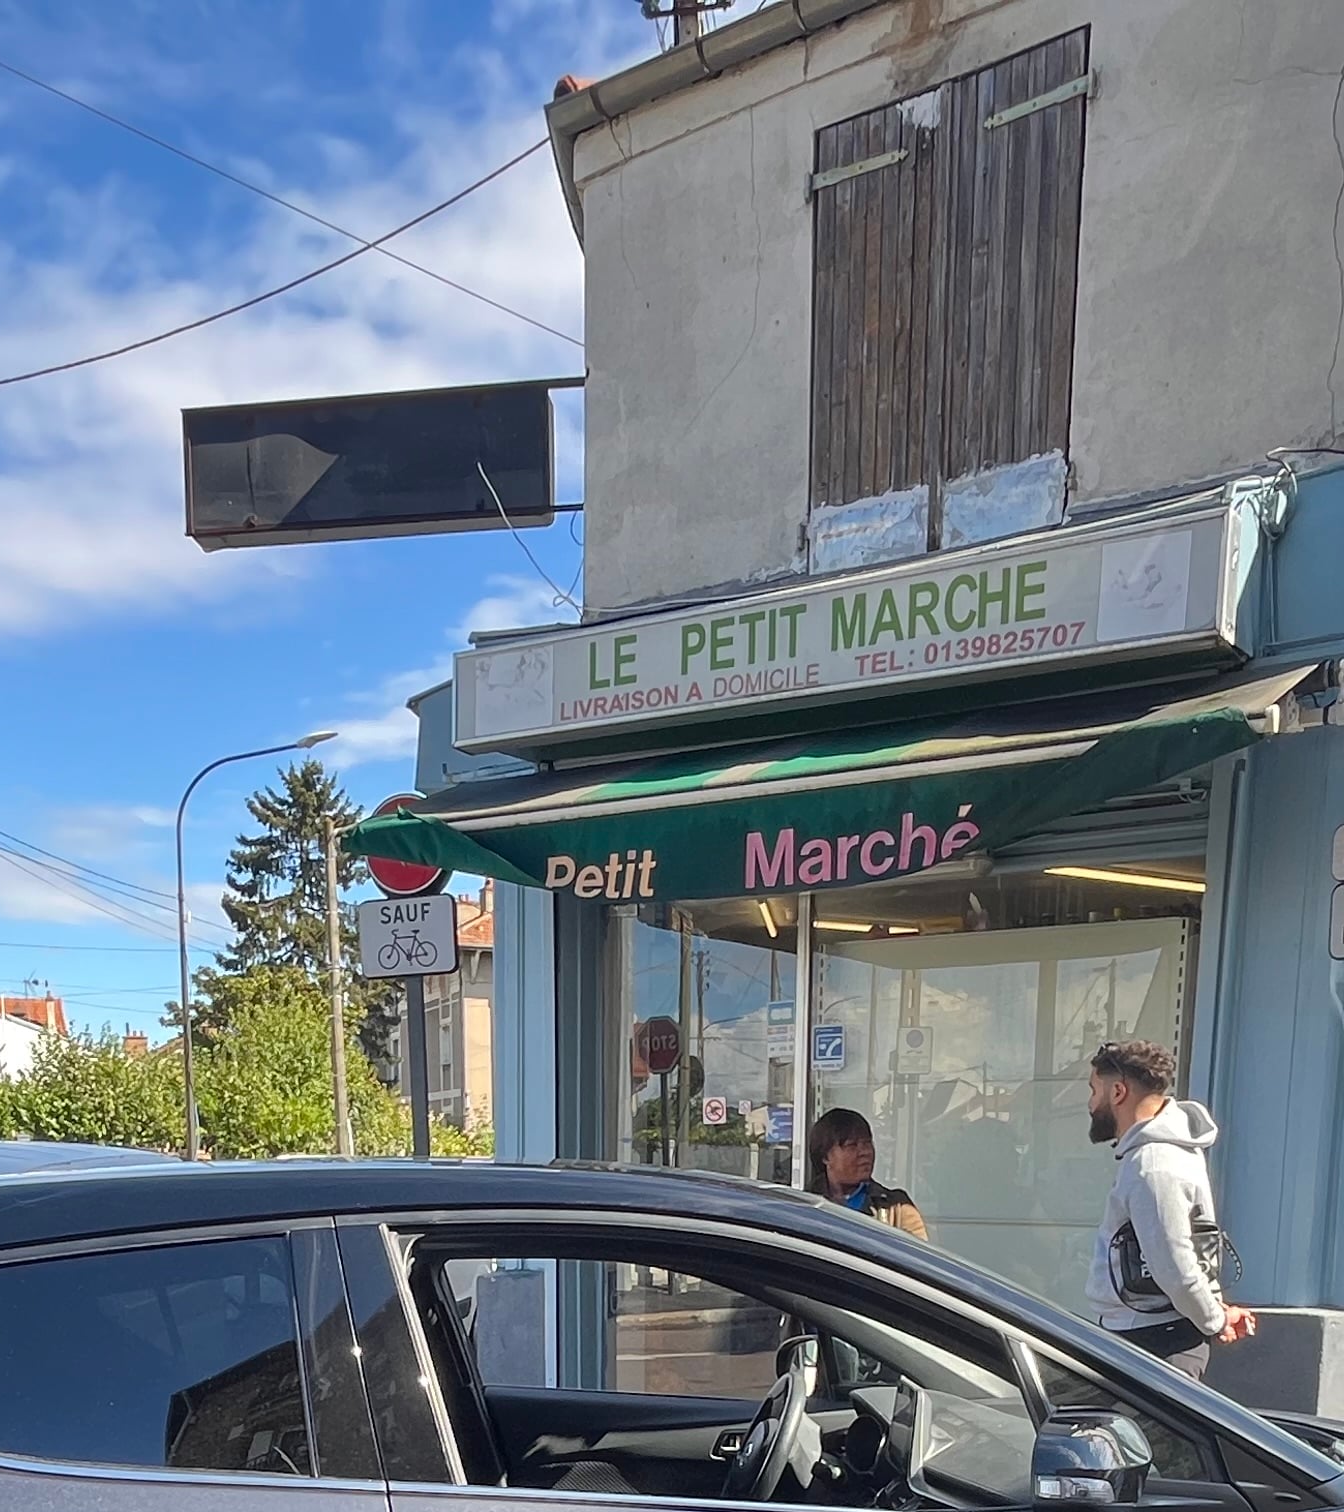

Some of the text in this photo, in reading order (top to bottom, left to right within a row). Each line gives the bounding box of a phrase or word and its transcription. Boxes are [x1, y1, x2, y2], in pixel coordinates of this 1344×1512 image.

[560, 685, 678, 721] LIVRAISON
[685, 681, 702, 700] A
[713, 663, 820, 697] DOMICILE
[924, 621, 1086, 665] 0139825707
[589, 560, 1047, 690] LE PETIT MARCHE
[545, 804, 981, 899] Petit Marché
[380, 902, 431, 925] SAUF
